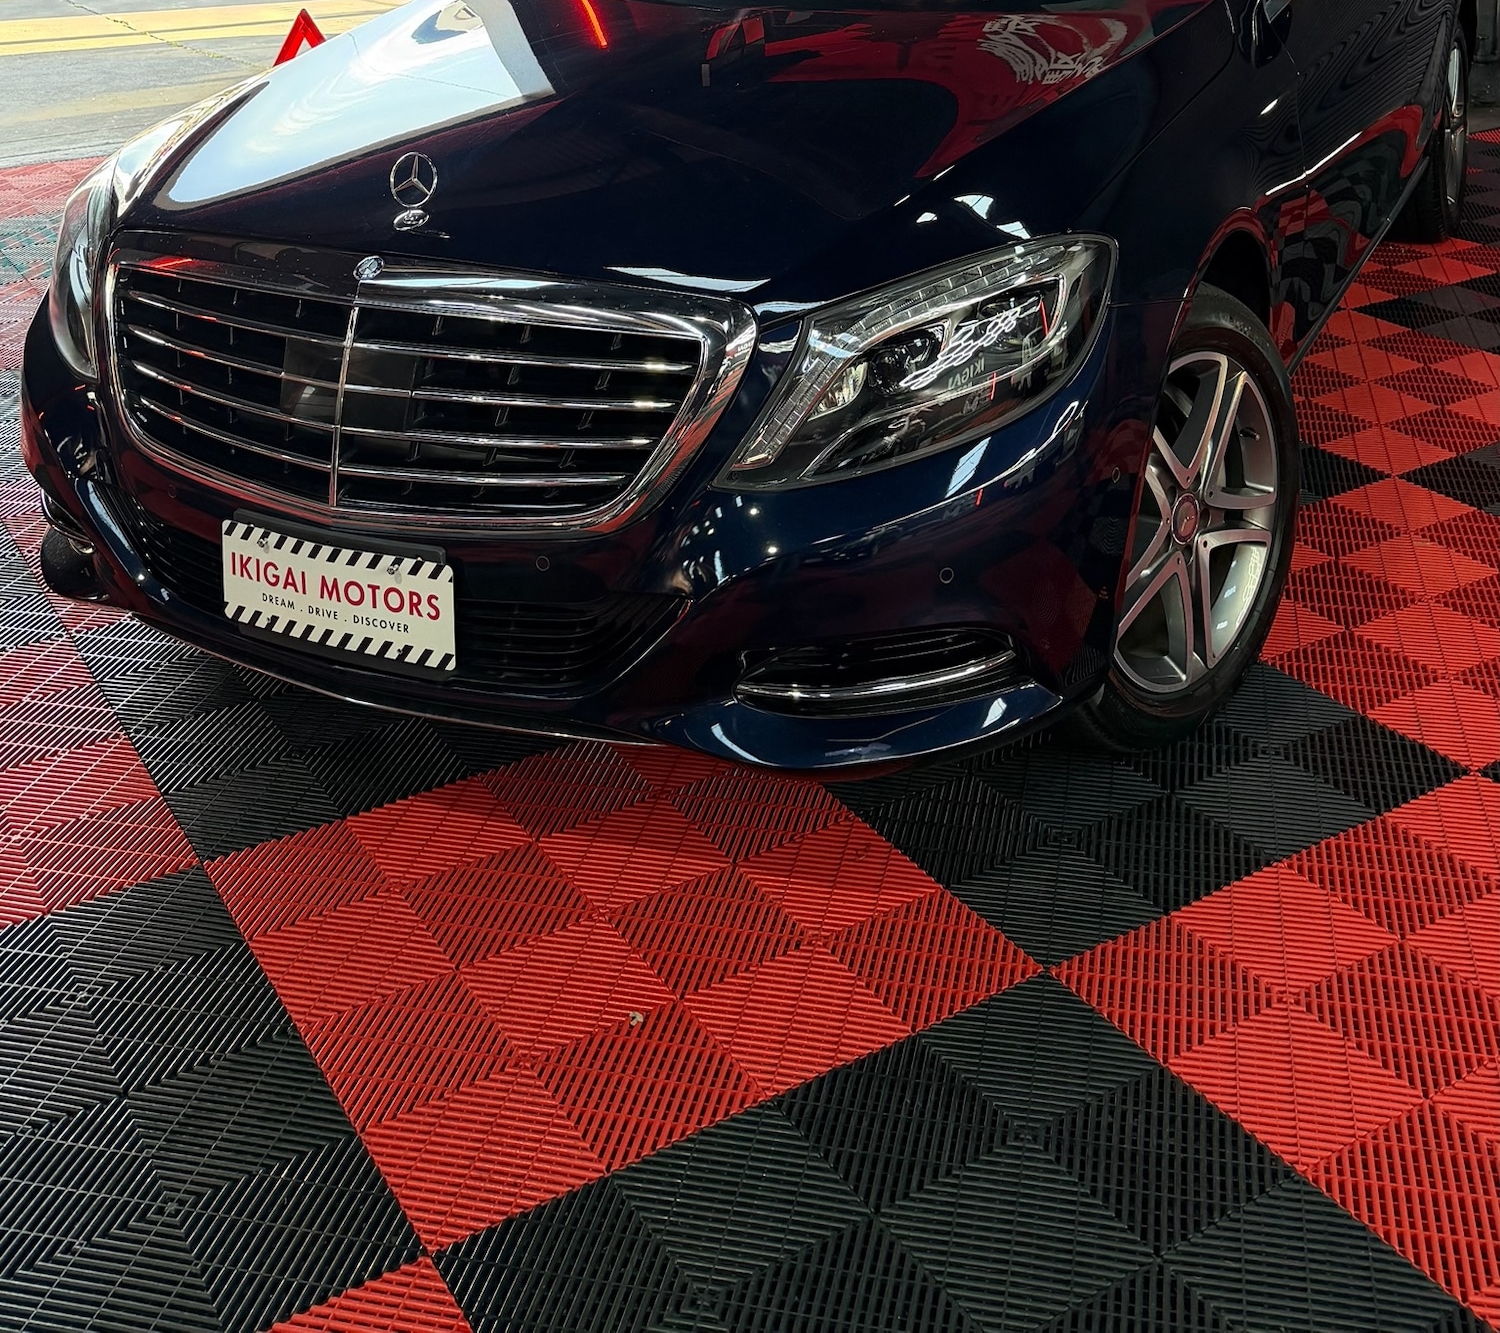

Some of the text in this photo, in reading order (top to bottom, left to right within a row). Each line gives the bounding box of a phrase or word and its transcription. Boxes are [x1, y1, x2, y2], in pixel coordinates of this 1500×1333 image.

[230, 552, 441, 622] IKIGAI MOTORS
[262, 592, 410, 634] DREAM DRIVE DISCOVER
